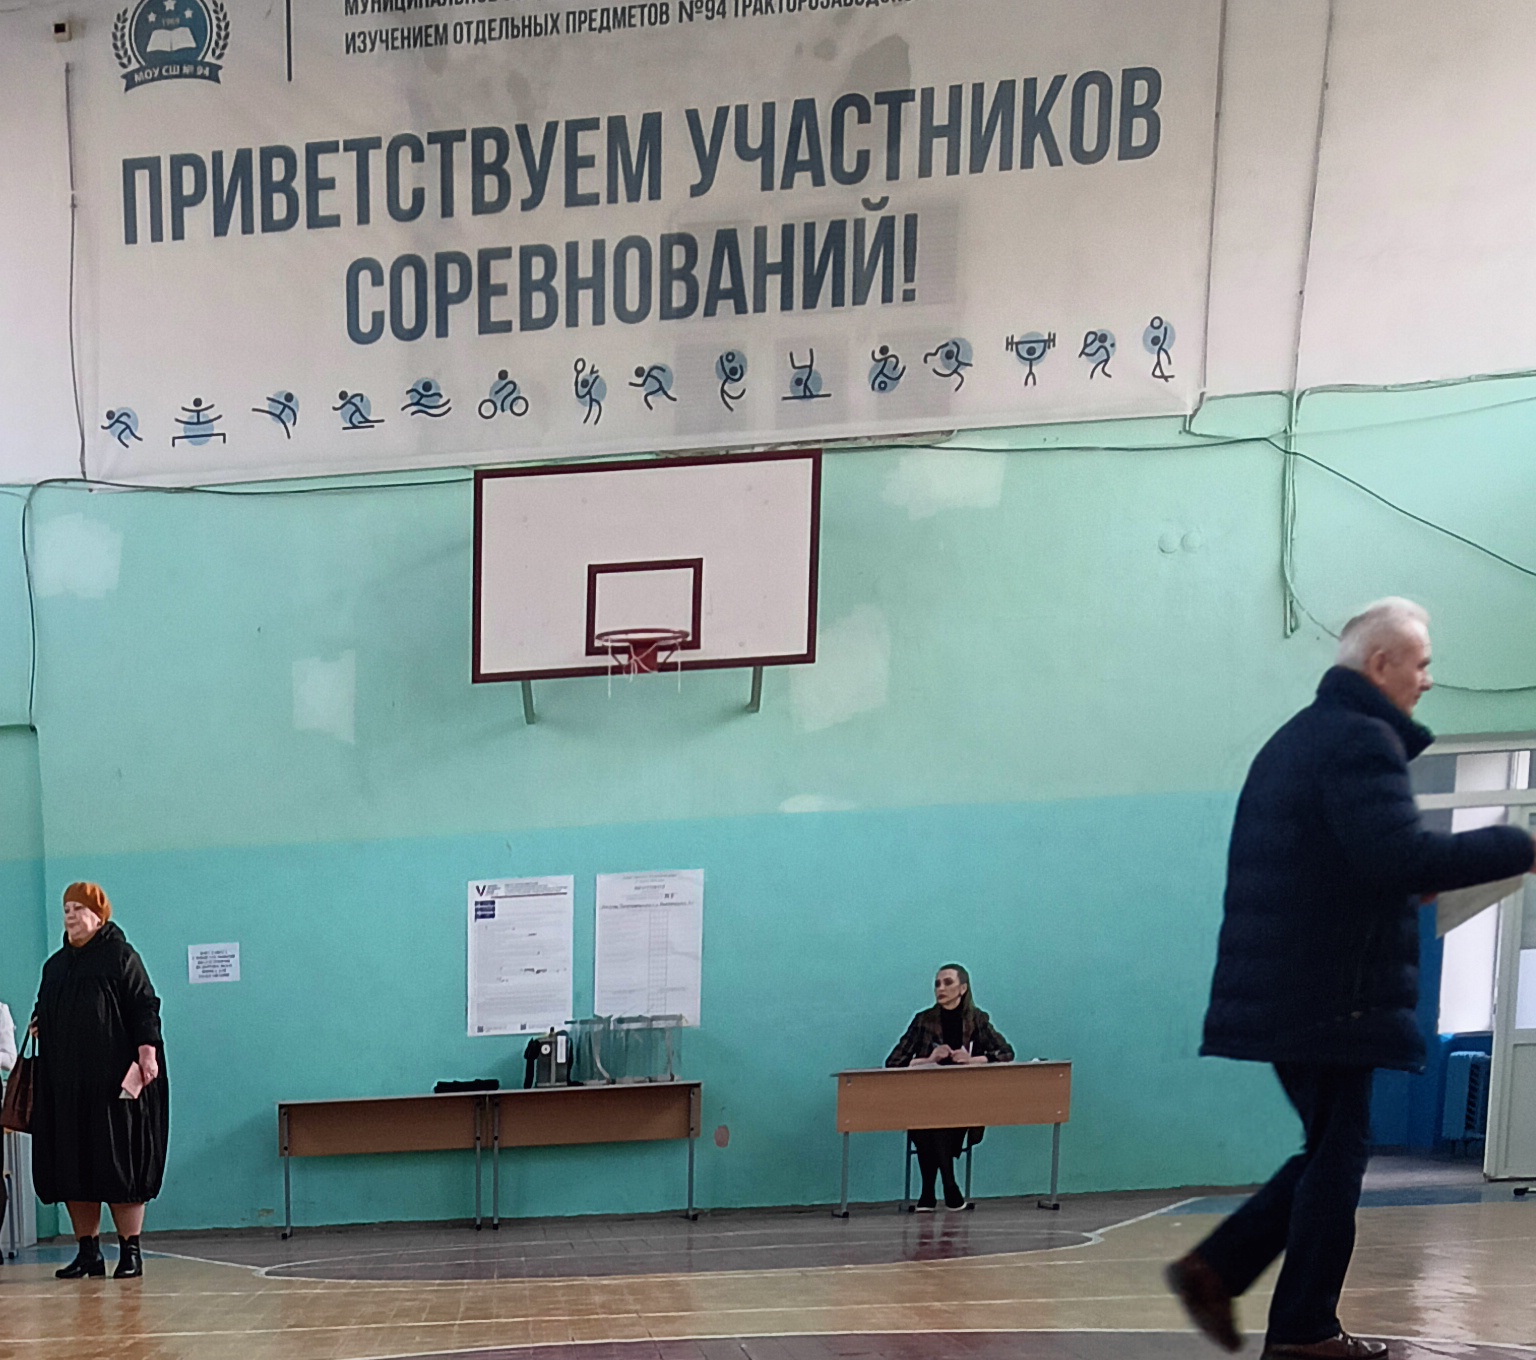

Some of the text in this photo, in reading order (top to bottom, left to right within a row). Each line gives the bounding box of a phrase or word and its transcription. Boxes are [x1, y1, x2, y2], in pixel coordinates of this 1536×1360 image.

[134, 66, 161, 84] МОУ
[162, 65, 180, 76] СШ
[345, 23, 449, 55] ИЗУЧЕНИЕМ
[453, 12, 561, 46] ОТДЕЛЬНЫХ
[565, 2, 670, 35] ПРЕДМЕТОВ
[121, 66, 1163, 246] ПРИВЕТСТВУЕМ УЧАСТНИКОВ
[345, 195, 920, 346] СОРЕВНОВАНИЙ!
